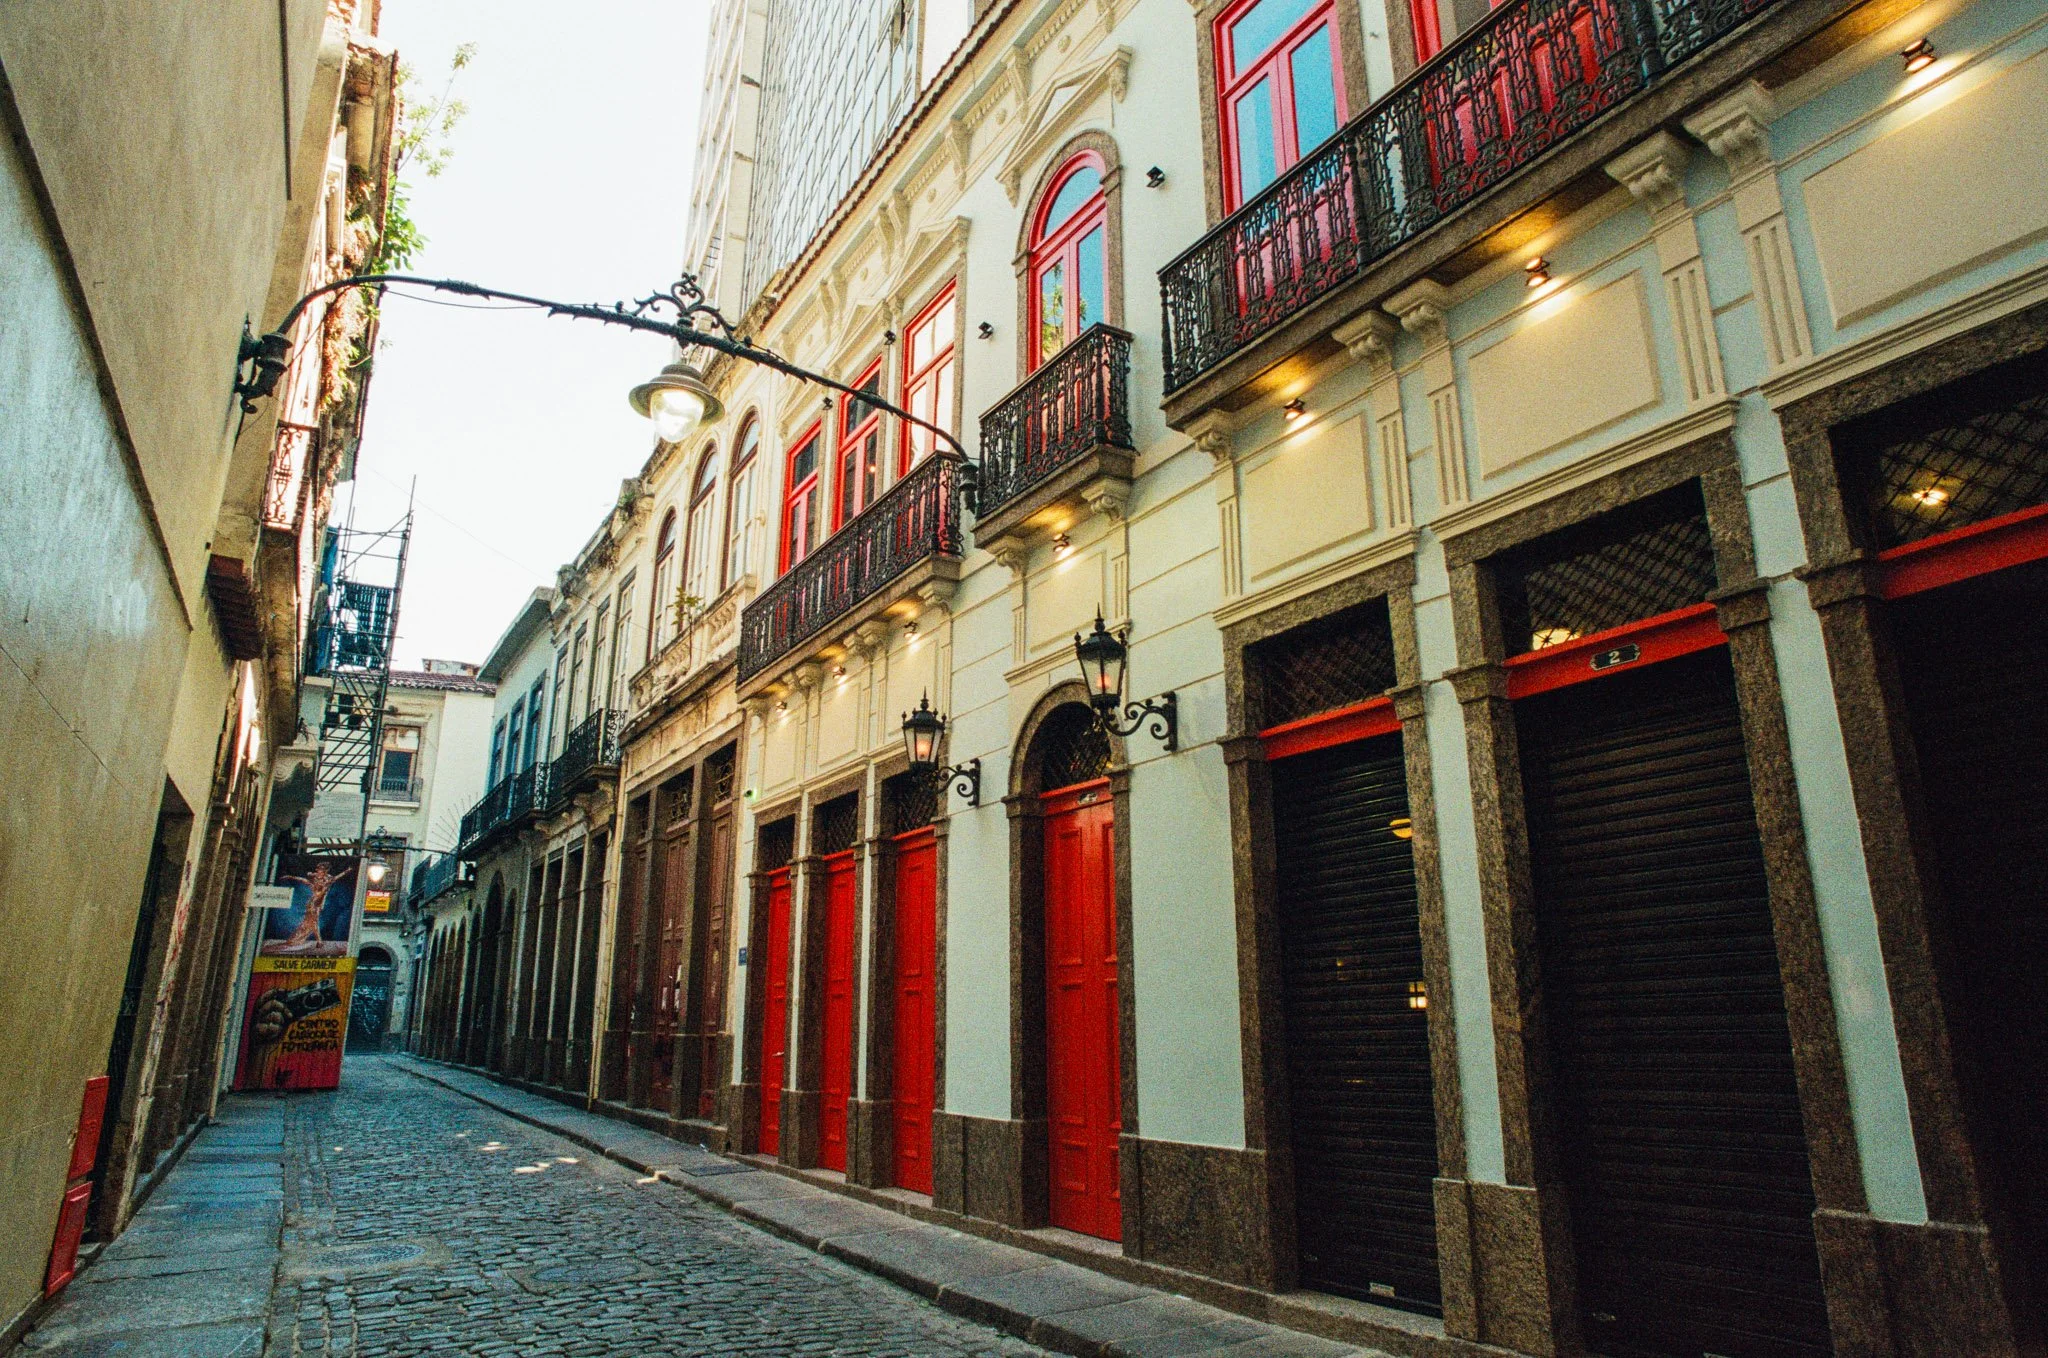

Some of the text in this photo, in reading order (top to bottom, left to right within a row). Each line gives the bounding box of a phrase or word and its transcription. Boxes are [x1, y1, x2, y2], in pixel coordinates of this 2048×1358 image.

[1609, 650, 1620, 664] 2
[273, 959, 298, 970] SALVE
[297, 1019, 339, 1030] CENTRO
[282, 1040, 338, 1052] FOTOGRAFIA
